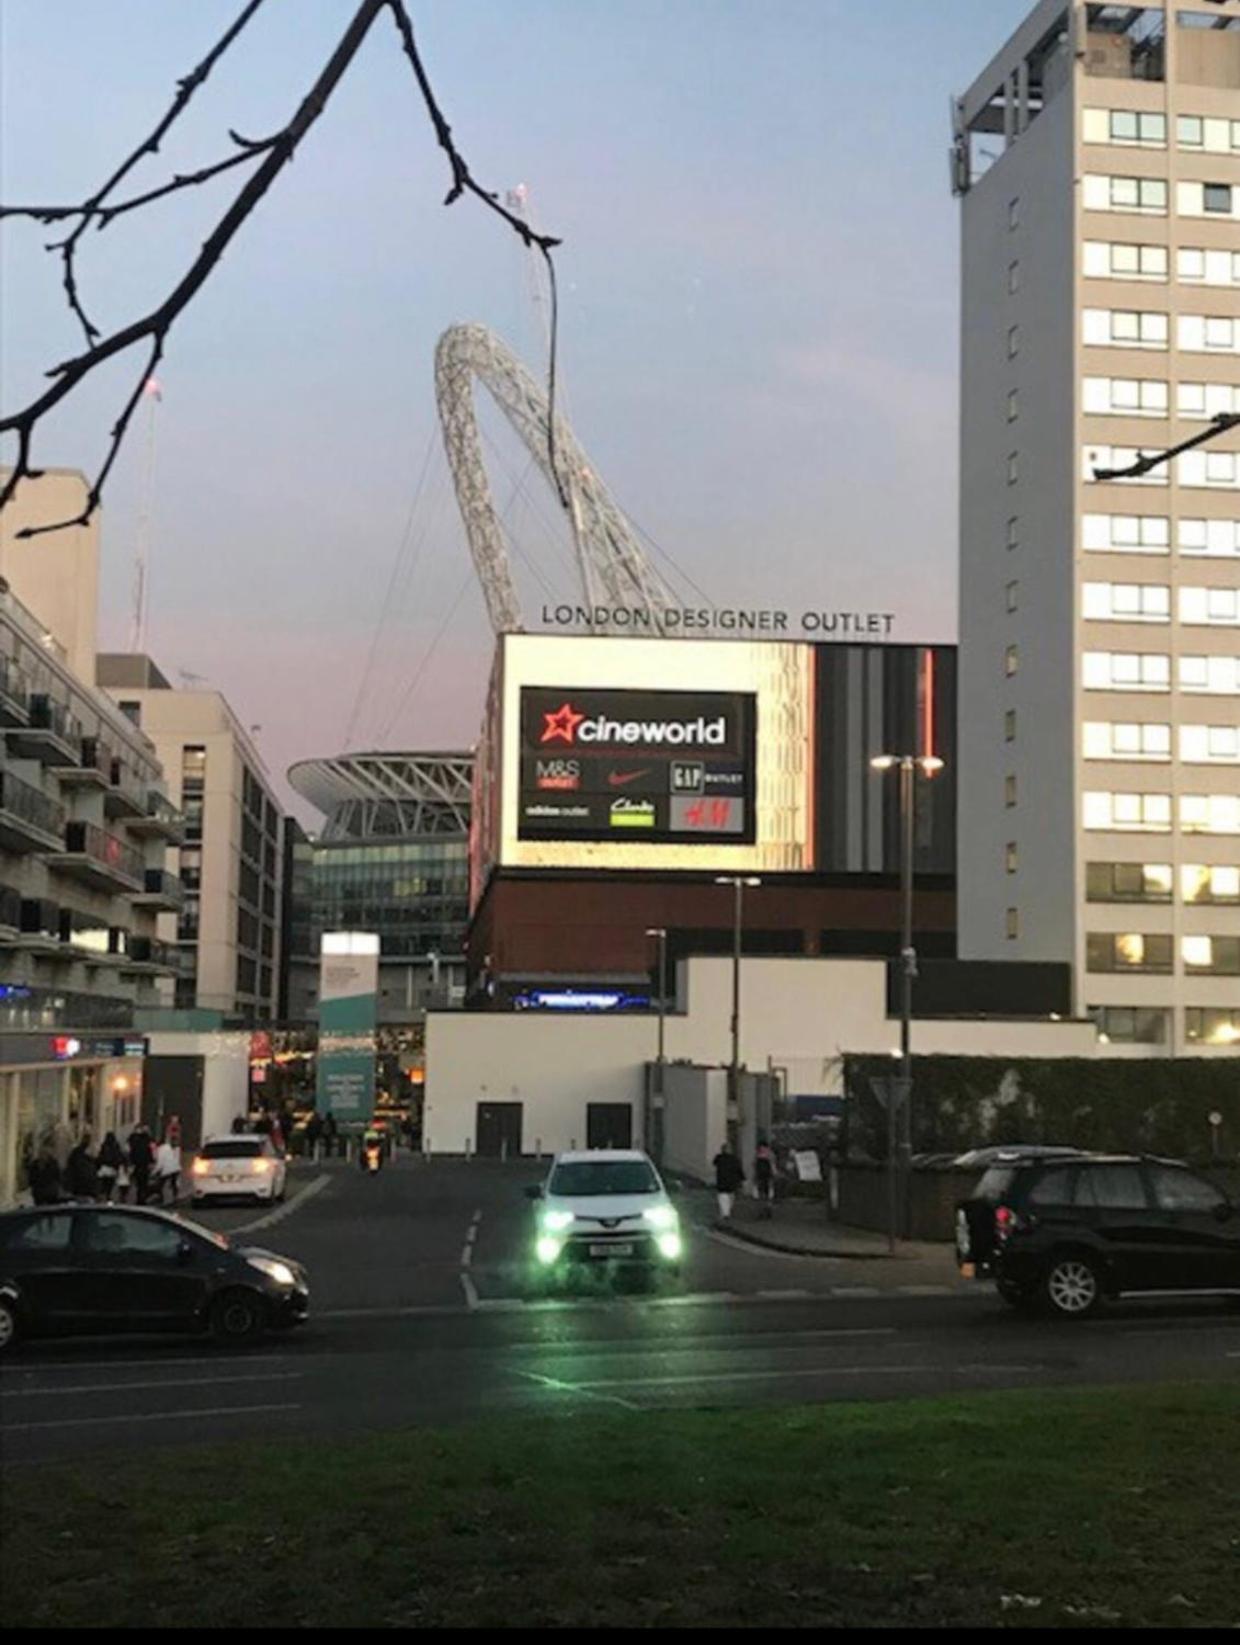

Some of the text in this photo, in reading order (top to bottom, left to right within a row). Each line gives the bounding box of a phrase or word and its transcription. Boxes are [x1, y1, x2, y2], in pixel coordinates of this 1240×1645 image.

[542, 605, 895, 633] LONDON DESIGNER OUTLET
[577, 715, 725, 744] cineworld
[536, 759, 580, 777] M&S
[674, 767, 701, 787] GAP
